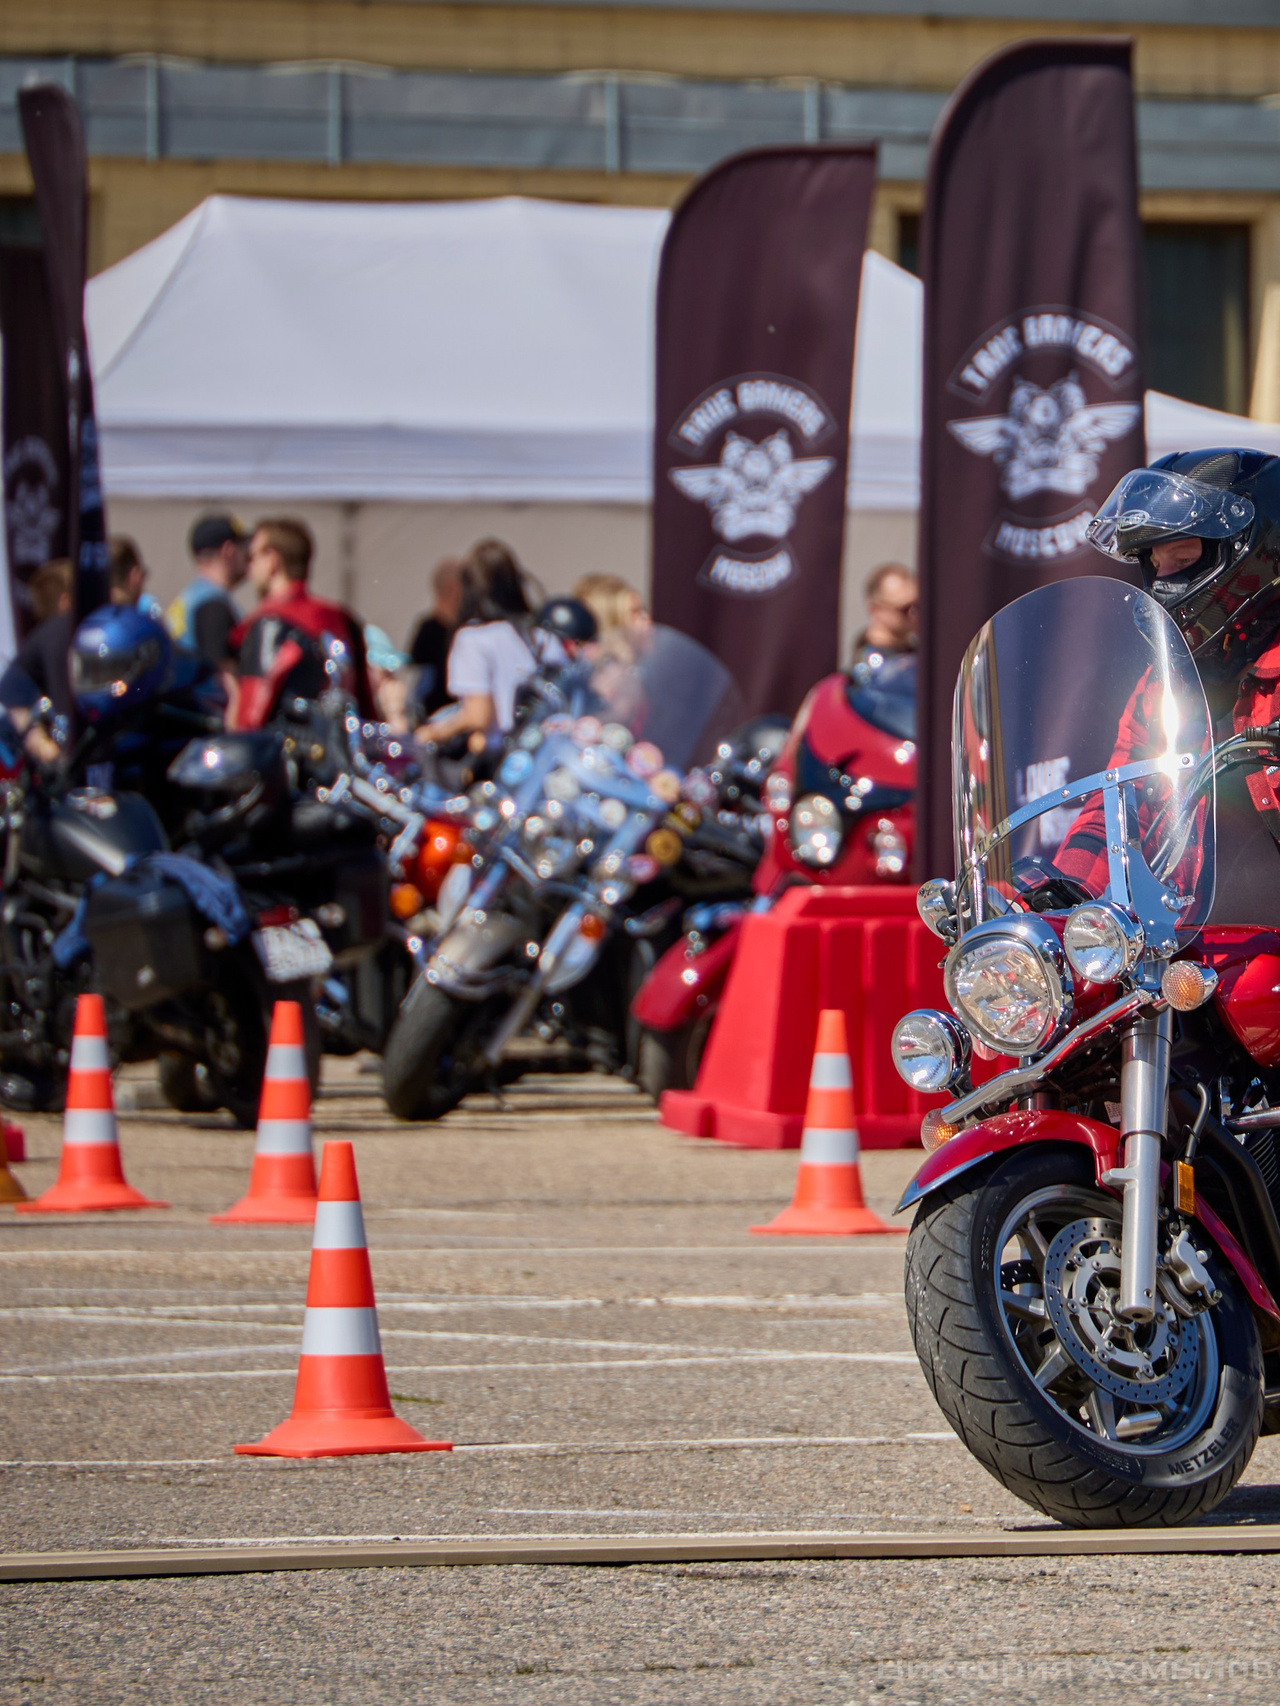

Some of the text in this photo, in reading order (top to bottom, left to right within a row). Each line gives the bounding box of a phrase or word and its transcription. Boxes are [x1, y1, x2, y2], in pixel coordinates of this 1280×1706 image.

[1023, 313, 1132, 376] BANKERS
[736, 380, 826, 438] BANKERS
[995, 511, 1094, 557] MOSCOW
[1167, 1416, 1240, 1476] METZELER
